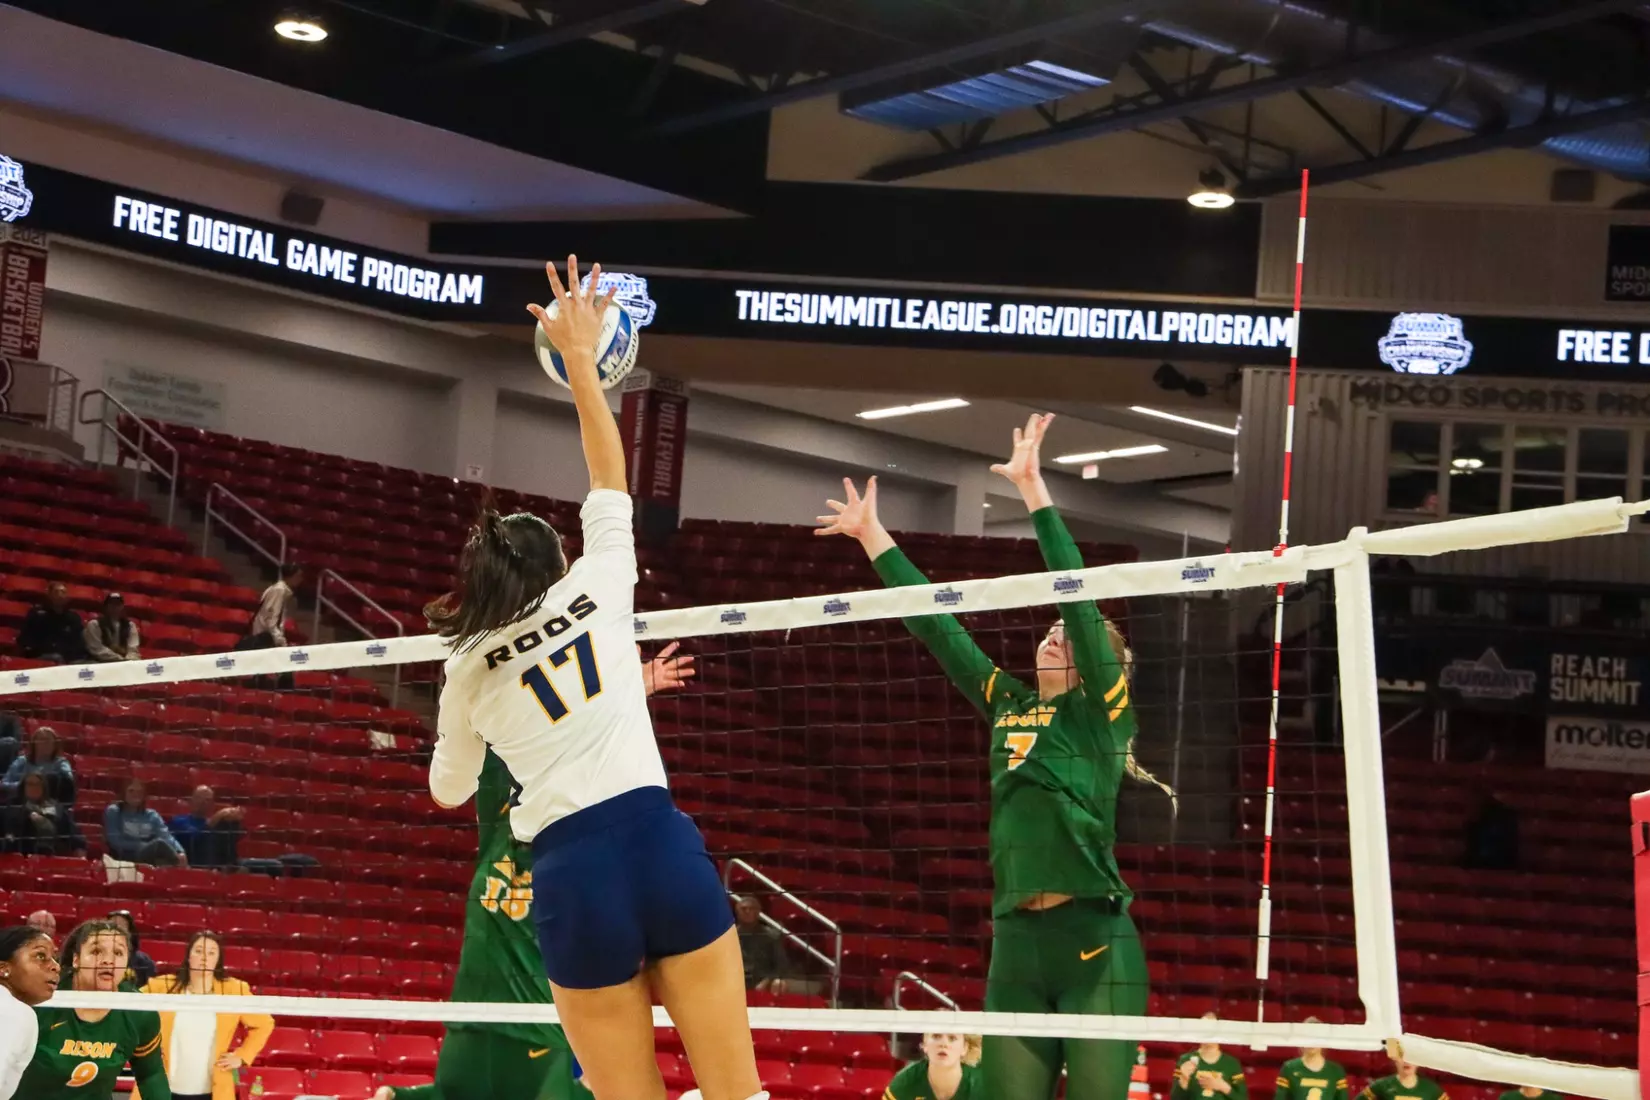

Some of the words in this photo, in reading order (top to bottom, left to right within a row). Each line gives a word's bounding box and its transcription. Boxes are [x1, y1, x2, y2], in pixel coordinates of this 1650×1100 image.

[113, 195, 180, 241] FREE
[186, 213, 279, 265] DIGITAL
[286, 238, 357, 283] GAME
[361, 256, 483, 304] PROGRAM
[1611, 265, 1650, 280] MID
[1611, 281, 1650, 296] SPO
[0, 253, 30, 355] BASKETBAL
[735, 290, 1294, 347] THESUMMITLEAGUE.ORG/DIGITALPROGRAM
[1557, 329, 1631, 364] FREE
[1463, 386, 1585, 413] SPORTS
[484, 593, 597, 670] ROOS
[520, 631, 602, 724] 17
[1551, 653, 1627, 679] REACH
[1551, 677, 1642, 705] SUMMIT
[1555, 723, 1650, 749] molte
[1005, 732, 1038, 770] 7
[59, 1039, 117, 1058] BISON
[66, 1061, 99, 1087] 9
